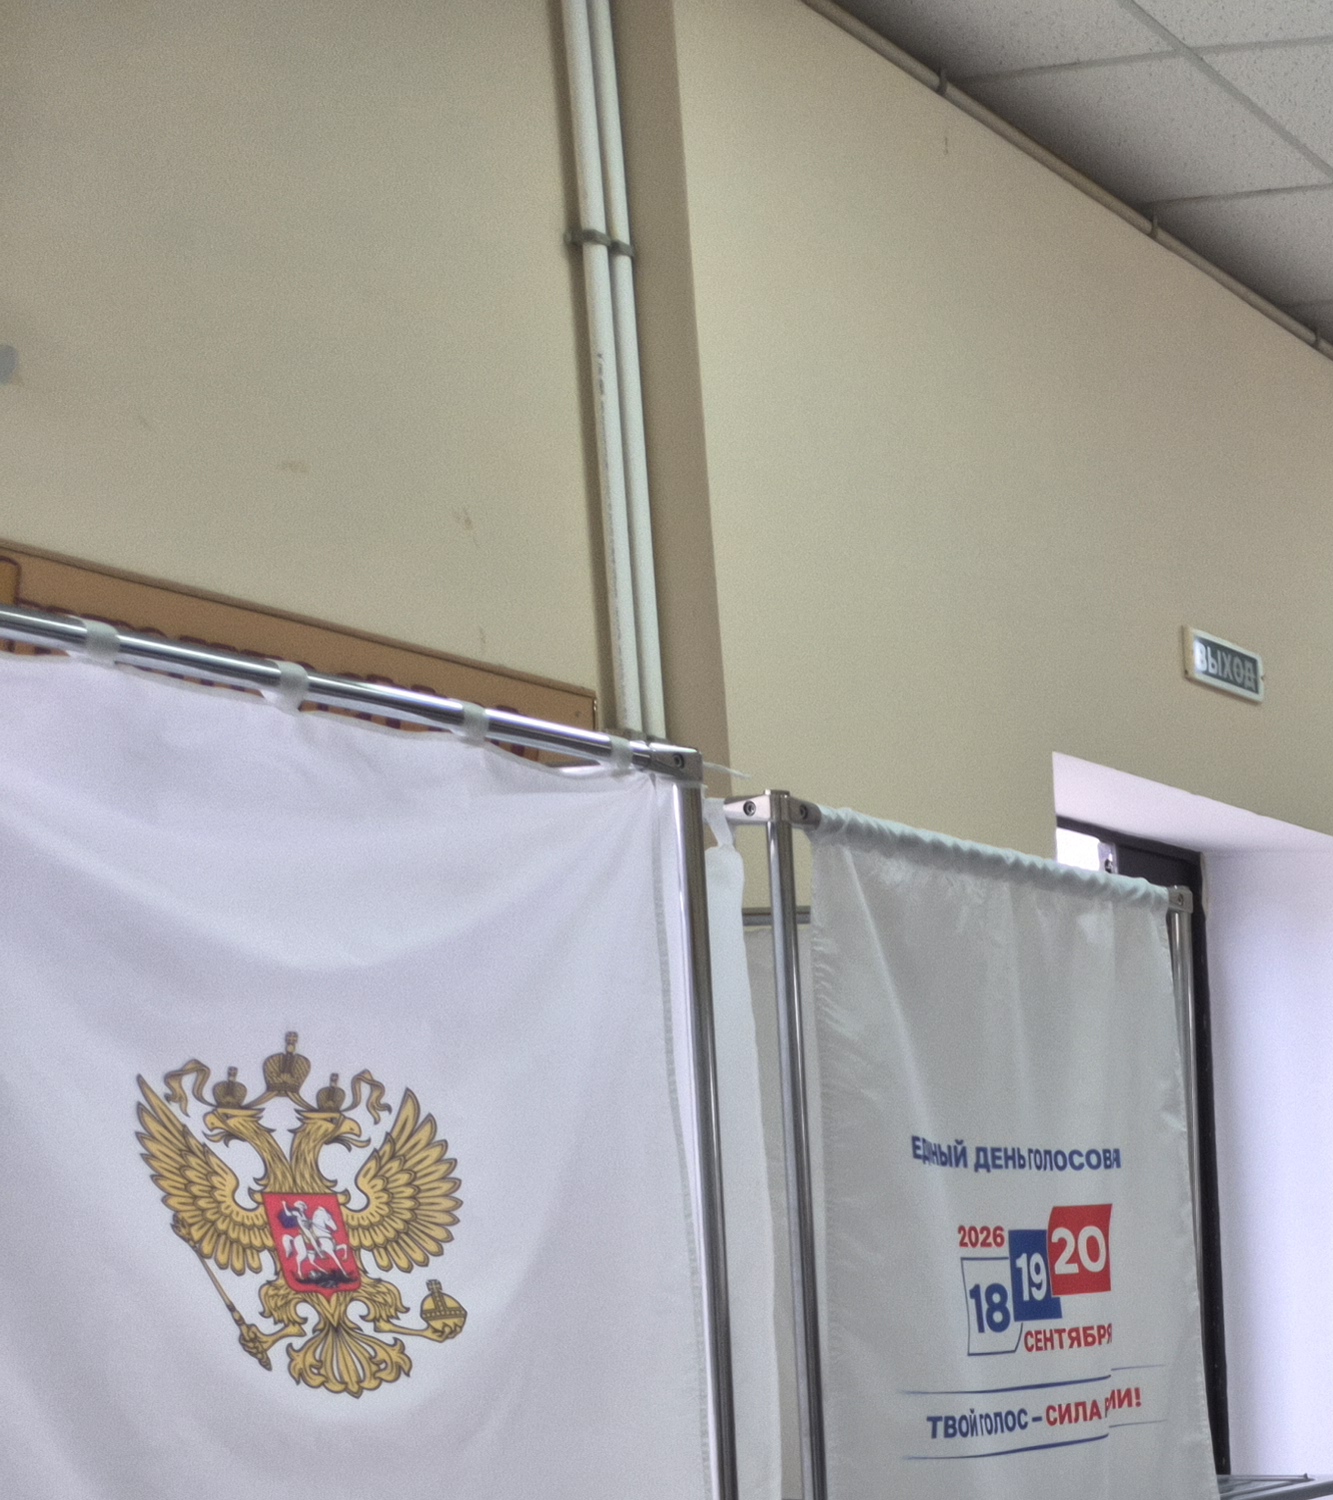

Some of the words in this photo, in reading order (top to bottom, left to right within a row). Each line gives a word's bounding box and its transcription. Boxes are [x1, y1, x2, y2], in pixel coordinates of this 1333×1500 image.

[1194, 640, 1256, 691] ВЫХОД
[974, 1147, 1026, 1172] ДЕНЬ
[957, 1225, 1006, 1248] 2026
[1051, 1225, 1107, 1275] 20
[1015, 1252, 1048, 1302] 19
[969, 1283, 1012, 1334] 18
[1023, 1323, 1113, 1353] СЕНТЯБРЯ
[926, 1408, 979, 1439] ТВОЙ
[979, 1408, 1029, 1436] ГОЛОС
[1045, 1400, 1102, 1427] СИЛА
